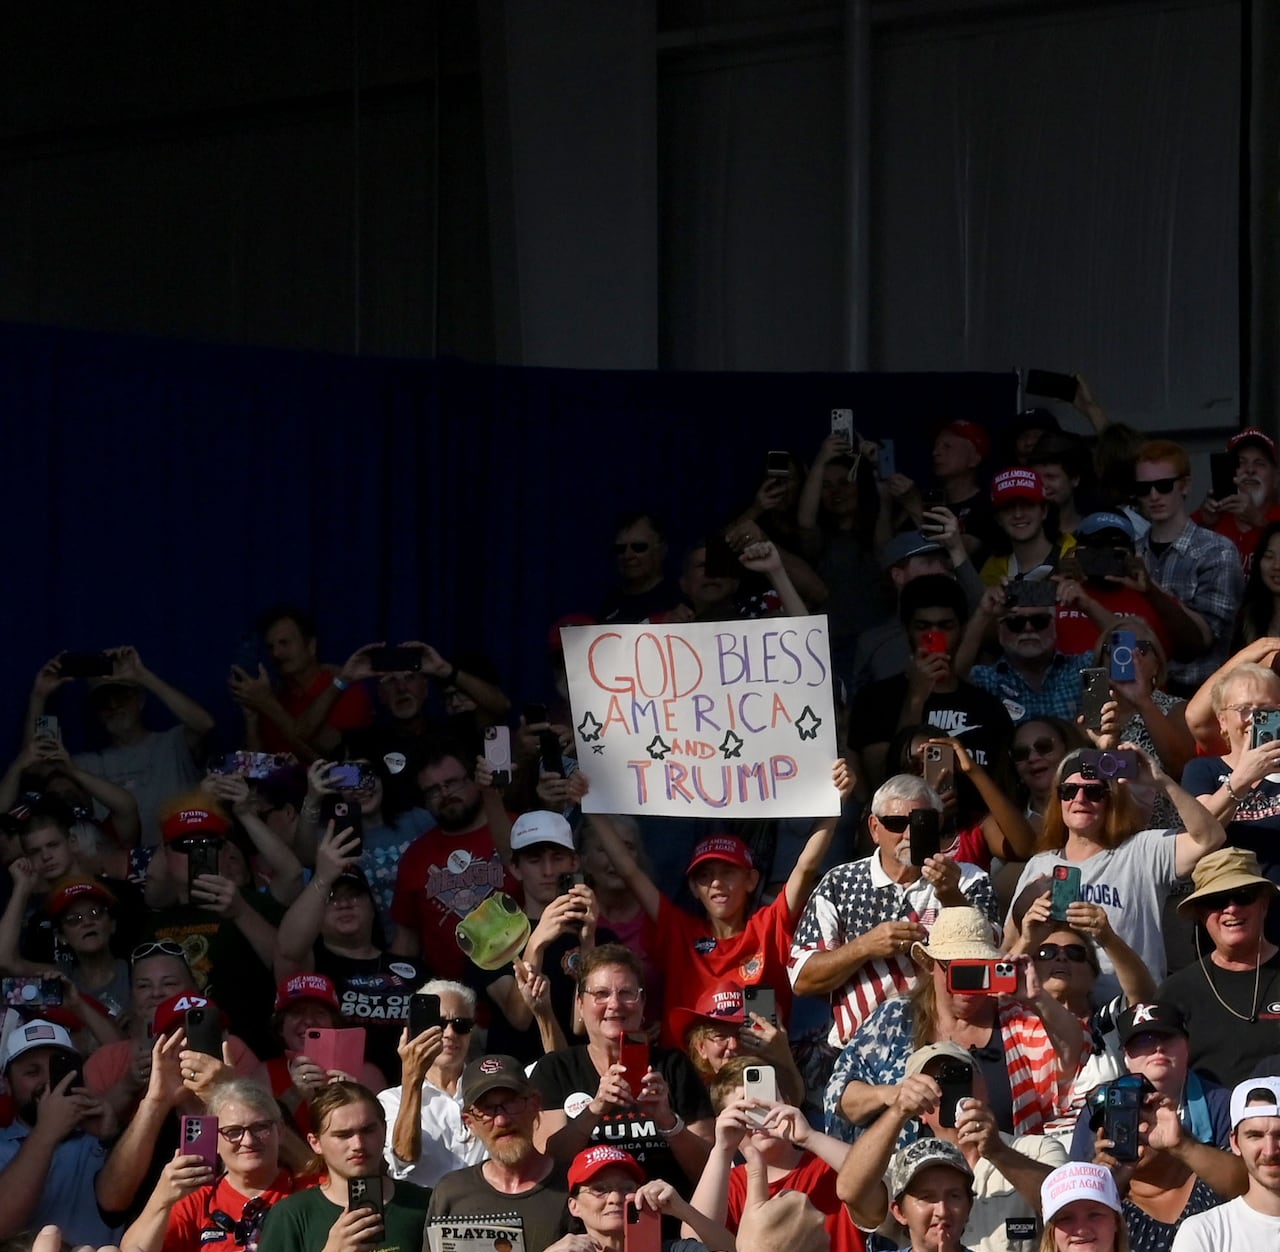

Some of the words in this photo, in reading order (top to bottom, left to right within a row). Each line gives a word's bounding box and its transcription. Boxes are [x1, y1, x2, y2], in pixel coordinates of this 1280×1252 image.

[590, 634, 703, 698] GOD
[715, 630, 829, 690] BLESS
[602, 693, 795, 738] AMERICA
[928, 710, 967, 730] NIKE
[671, 738, 716, 760] AND
[628, 756, 798, 809] TRUMP
[174, 996, 208, 1012] 47
[342, 990, 382, 1006] GET
[1069, 1167, 1108, 1181] AMERICA
[1079, 1180, 1105, 1193] AGAIN
[441, 1228, 519, 1242] PLAYBOY
